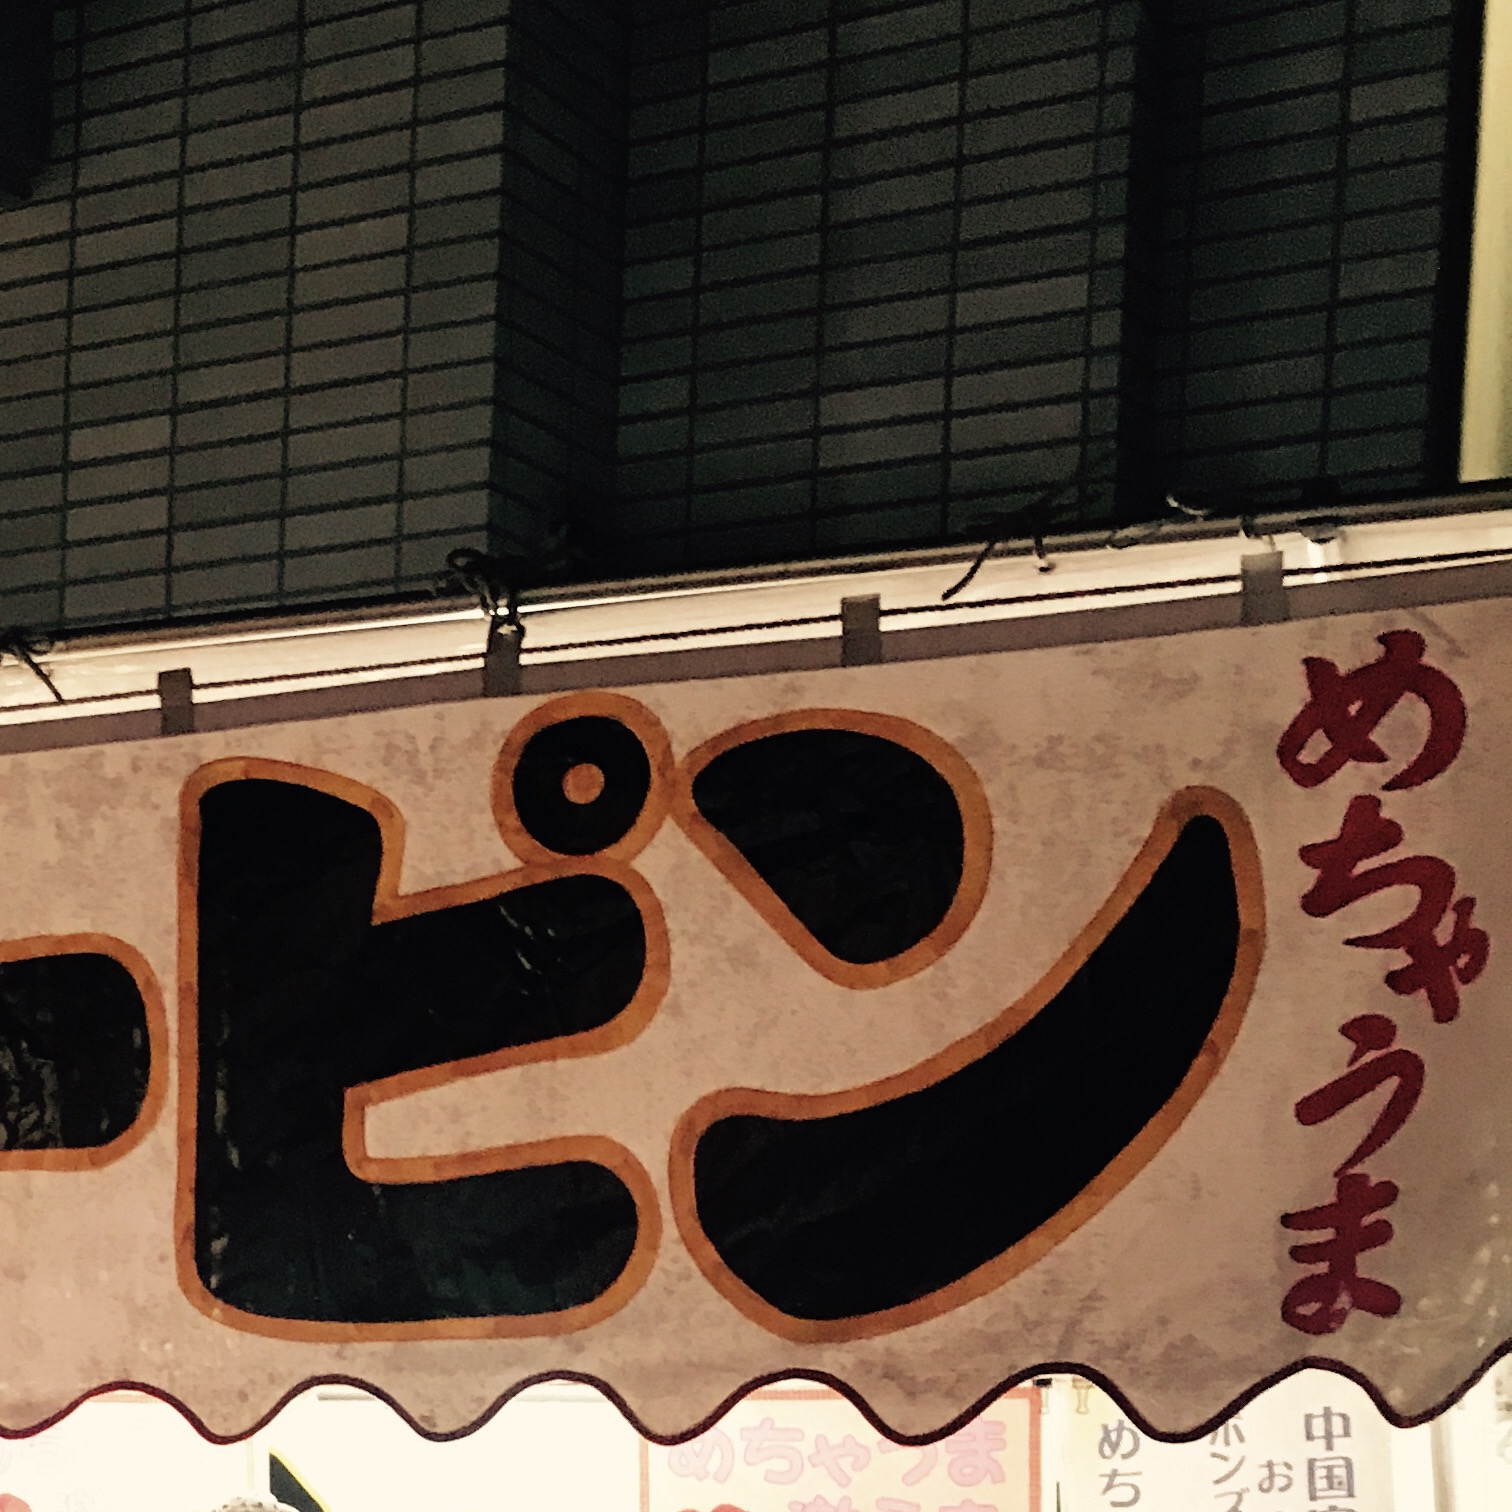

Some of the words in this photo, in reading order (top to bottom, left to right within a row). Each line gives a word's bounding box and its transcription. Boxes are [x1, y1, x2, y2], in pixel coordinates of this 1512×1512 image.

[1278, 629, 1488, 1337] めちゃうま
